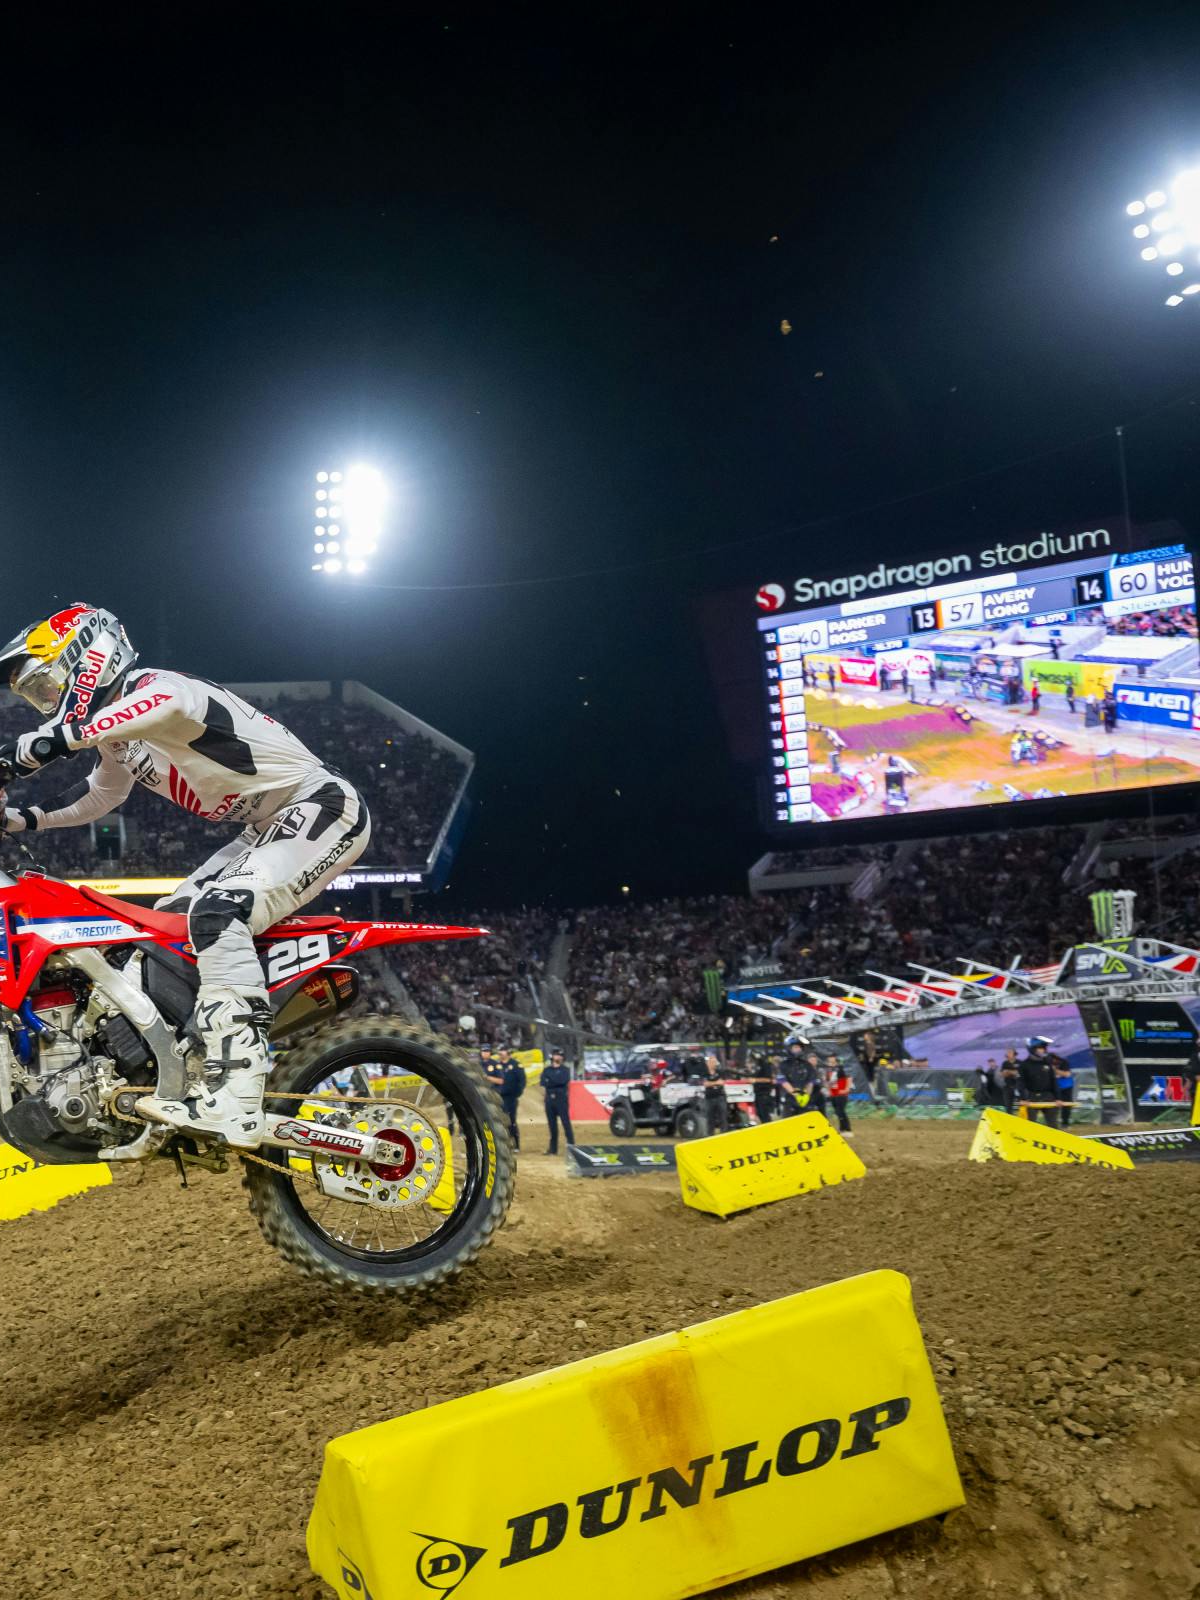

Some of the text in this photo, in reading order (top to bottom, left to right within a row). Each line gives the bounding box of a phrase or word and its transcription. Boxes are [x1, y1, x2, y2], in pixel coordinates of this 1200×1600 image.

[794, 554, 971, 602] Snapdragon
[980, 529, 1110, 568] stadium
[1080, 579, 1102, 600] 14
[1119, 572, 1148, 593] 60
[983, 587, 1037, 606] AVERY
[915, 607, 935, 629] 13
[950, 602, 974, 621] 57
[984, 602, 1029, 620] LONG
[829, 613, 886, 633] PARKER
[57, 613, 109, 673] 100%
[801, 628, 821, 645] 40
[829, 629, 868, 646] ROSS
[108, 644, 123, 677] FLY
[80, 692, 173, 740] HONDA
[308, 839, 354, 884] HONDA
[268, 934, 331, 983] 29
[1108, 1133, 1192, 1146] MONSTER
[728, 1134, 830, 1171] DUNLOP
[499, 1397, 912, 1569] DUNLOP
